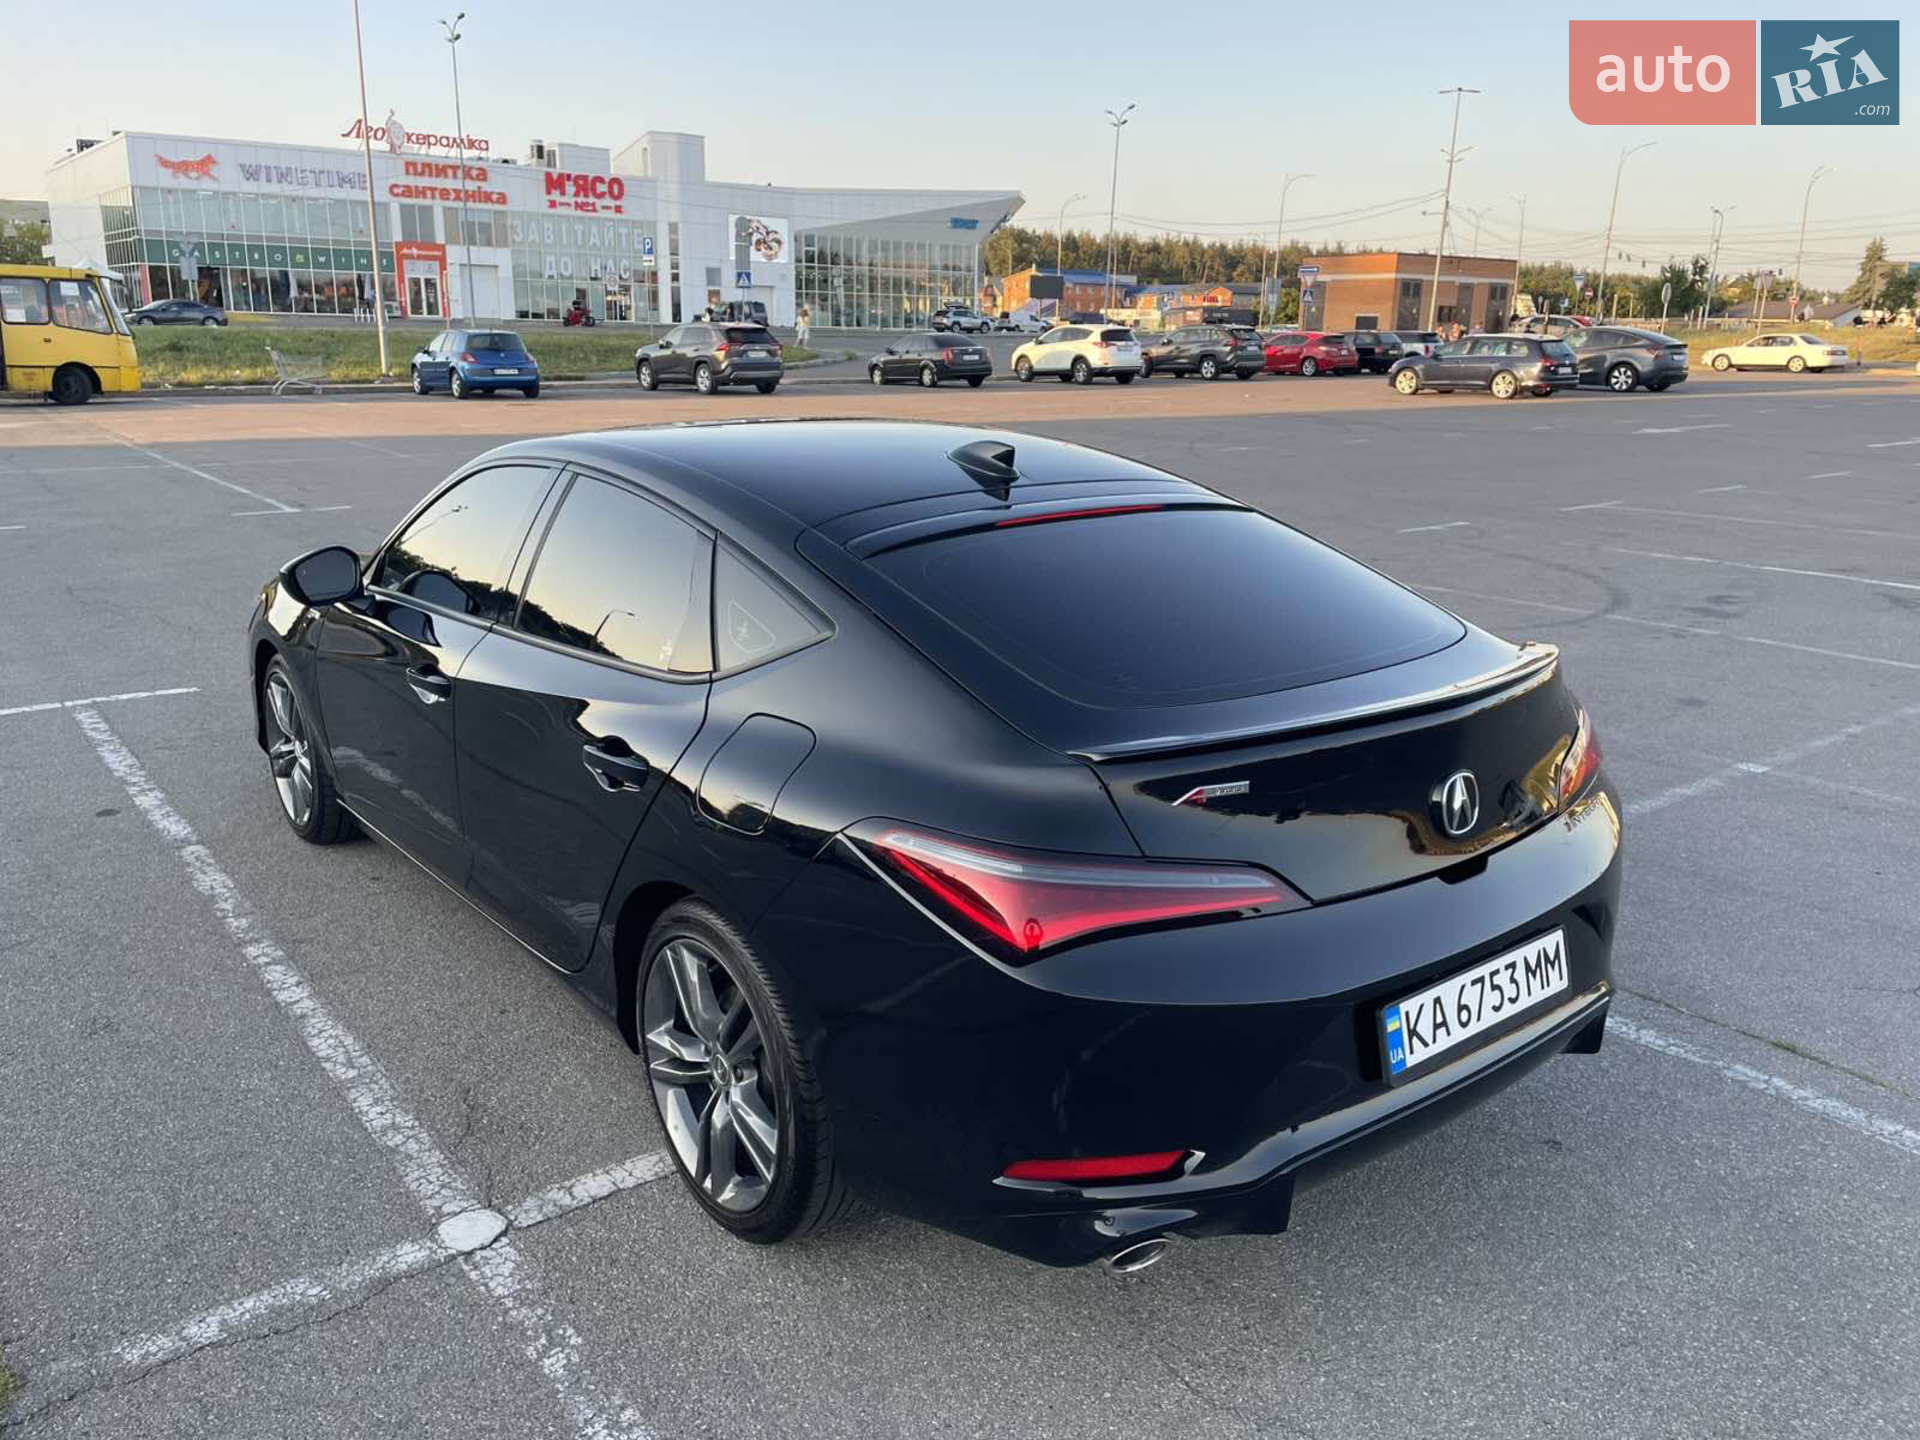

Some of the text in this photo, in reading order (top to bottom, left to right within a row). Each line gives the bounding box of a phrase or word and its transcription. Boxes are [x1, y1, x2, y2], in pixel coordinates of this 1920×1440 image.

[239, 163, 368, 191] WINETIME
[403, 160, 489, 182] плитка
[388, 182, 508, 205] сантехніка
[512, 219, 643, 251] ЗАВІТАЙТЕ
[544, 254, 572, 280] ДО
[1404, 940, 1564, 1056] KA 6753 MM
[1390, 1049, 1404, 1065] UA
